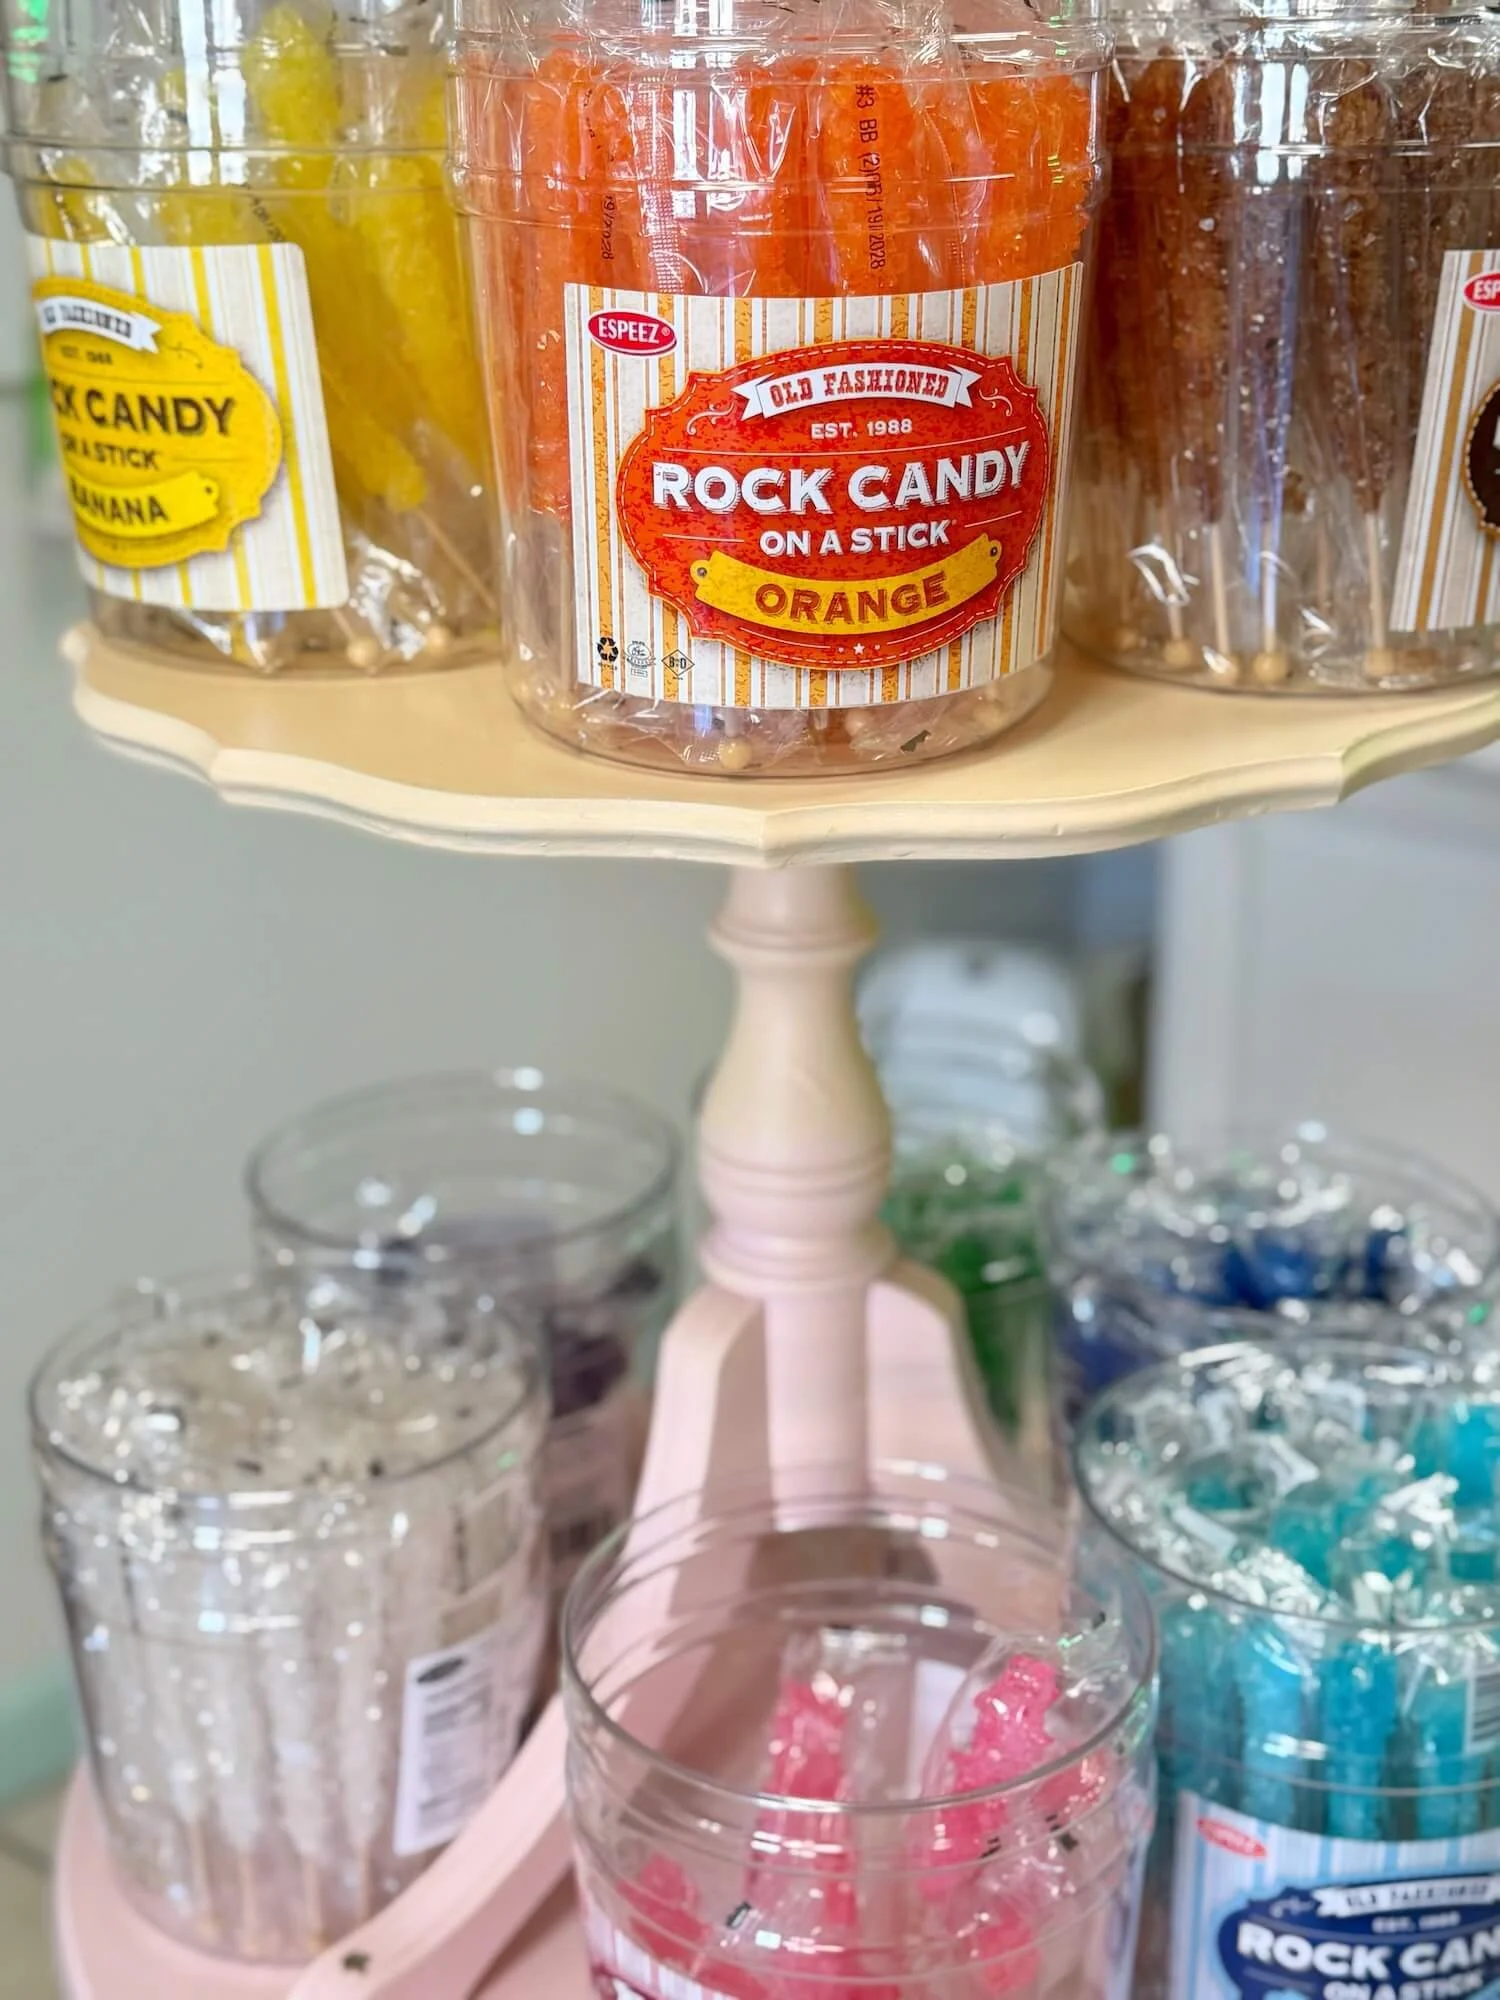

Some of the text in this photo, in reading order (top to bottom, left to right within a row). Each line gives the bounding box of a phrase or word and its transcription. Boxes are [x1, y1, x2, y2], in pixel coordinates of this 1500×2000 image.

[855, 84, 875, 108] #3
[858, 118, 878, 143] BB
[769, 369, 949, 407] OLD FASHIONED
[85, 388, 235, 437] CANDY
[811, 418, 913, 439] EST. 1988
[93, 442, 159, 470] STICK
[652, 440, 1031, 514] ROCK CANDY
[760, 520, 950, 557] ON A STICK
[755, 570, 949, 624] ORANGE
[1237, 1921, 1393, 1981] ROCK
